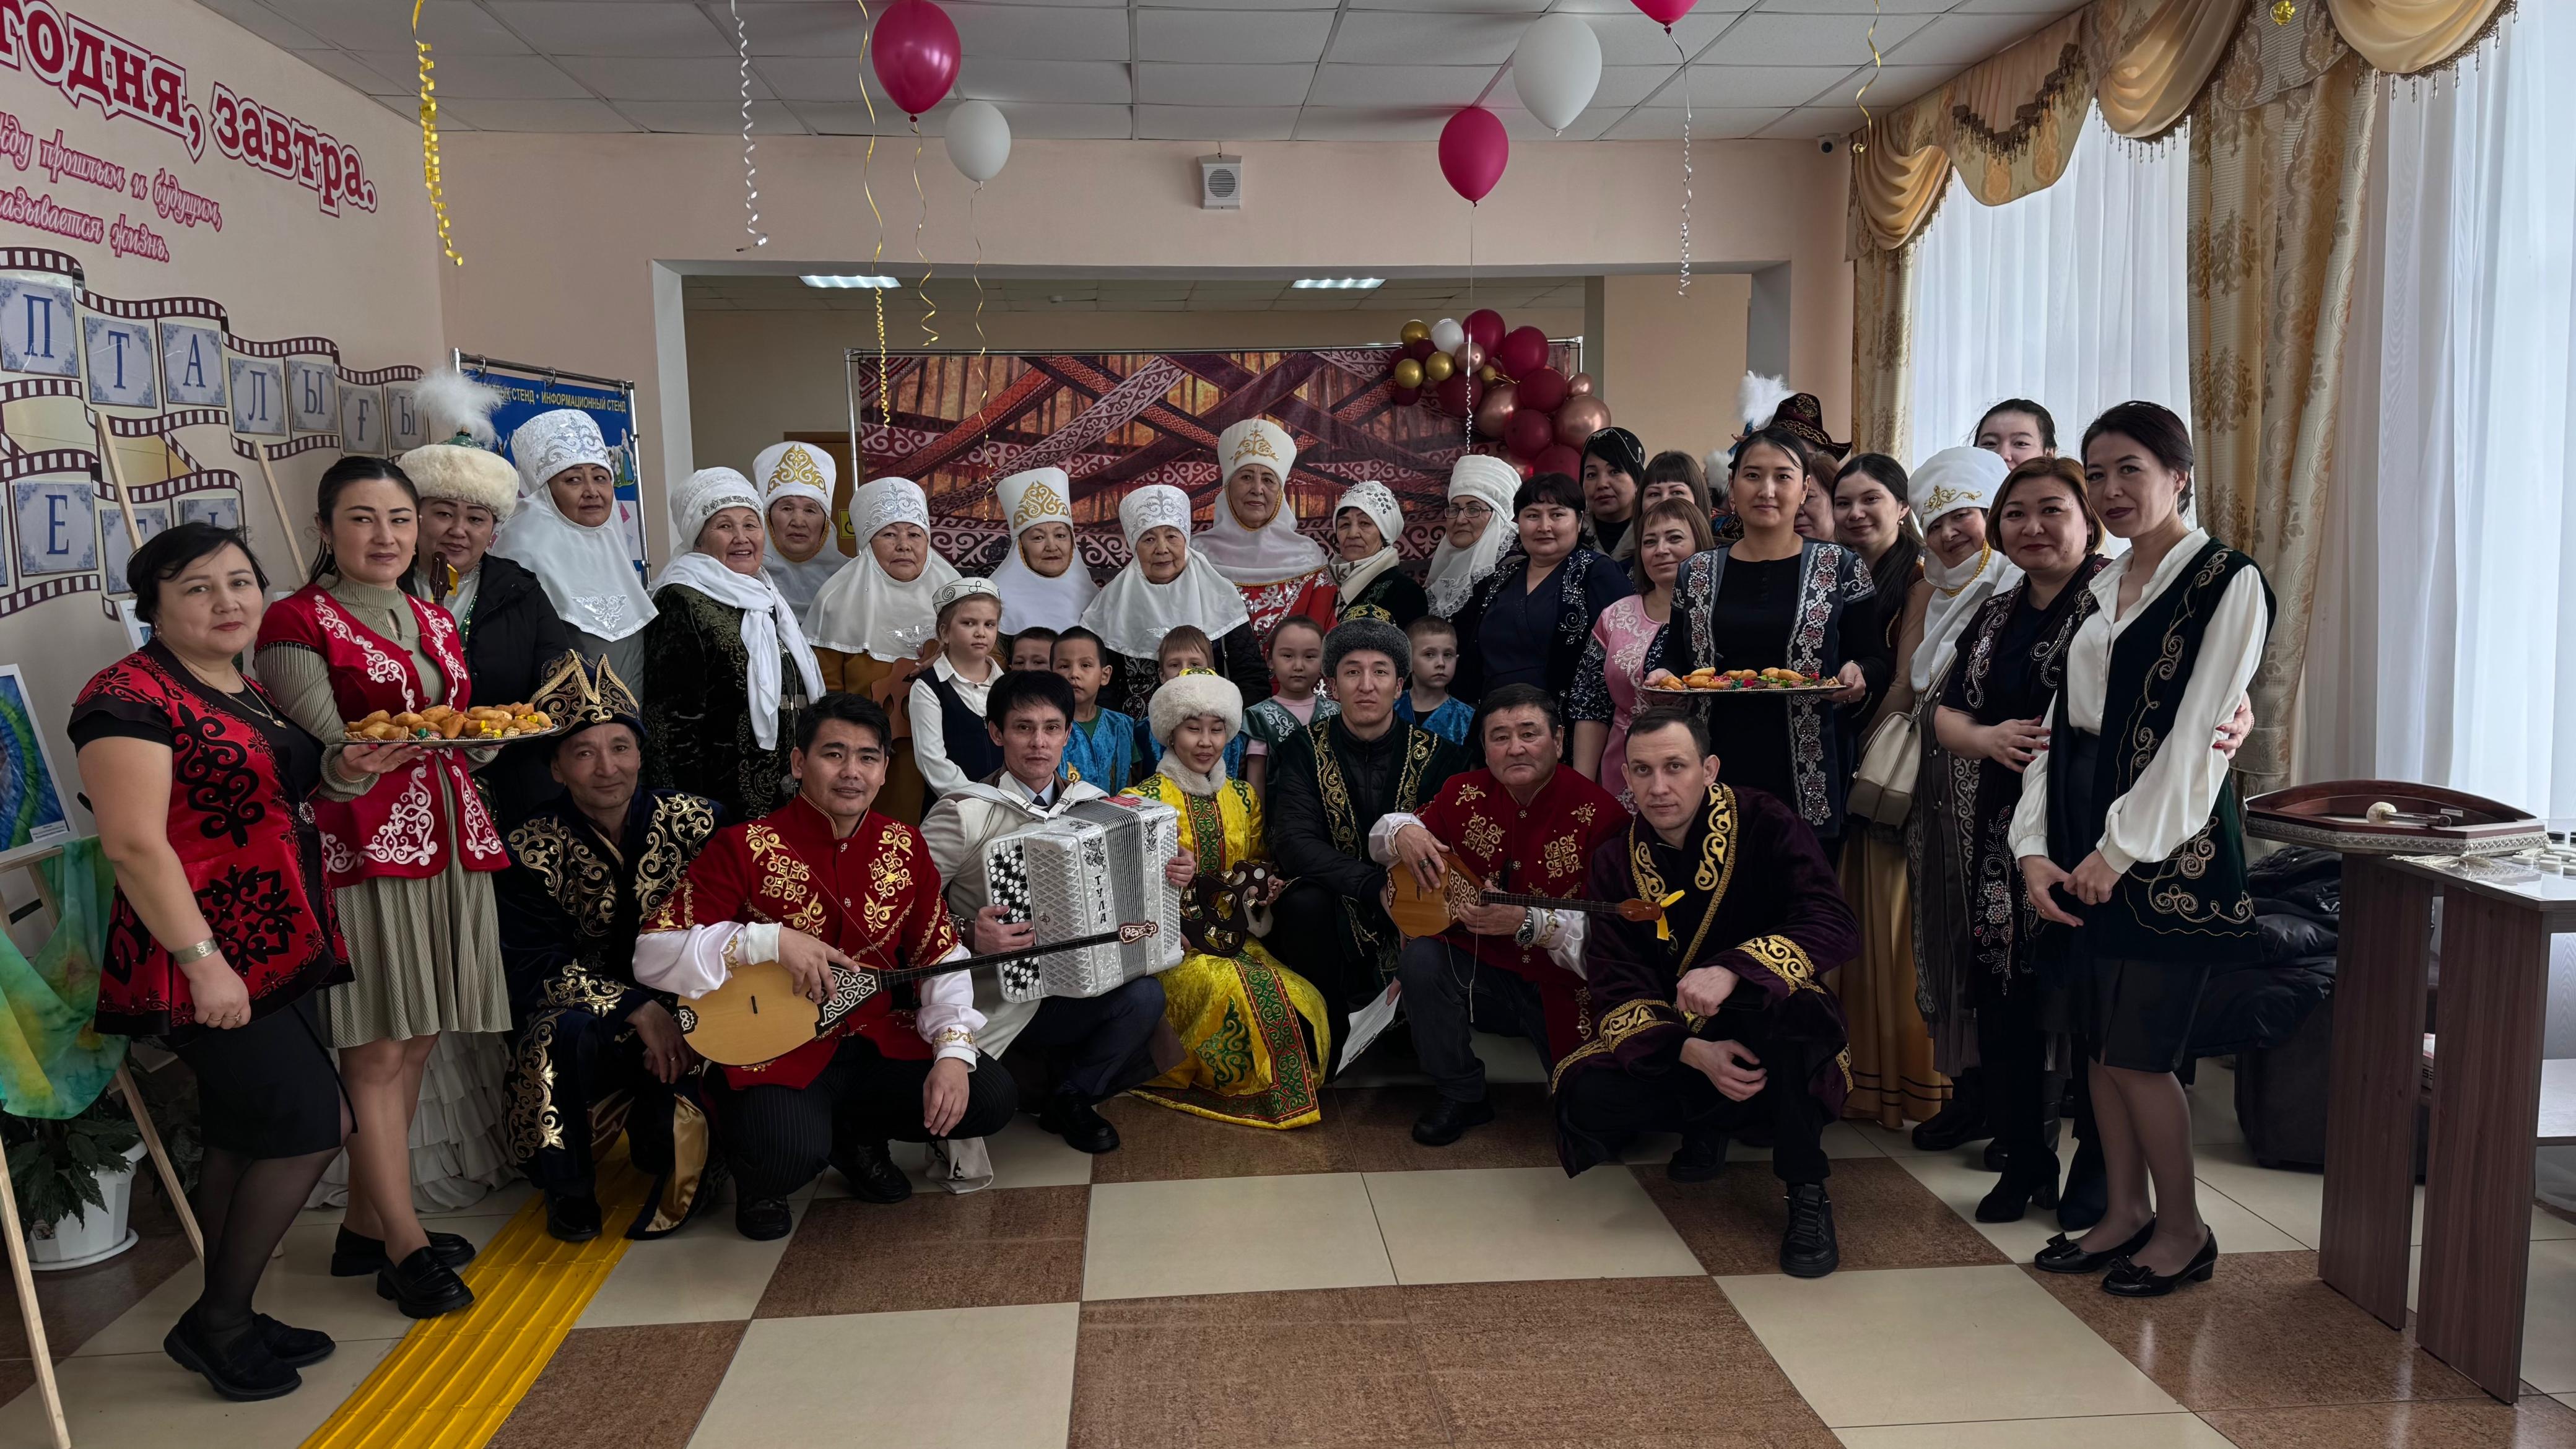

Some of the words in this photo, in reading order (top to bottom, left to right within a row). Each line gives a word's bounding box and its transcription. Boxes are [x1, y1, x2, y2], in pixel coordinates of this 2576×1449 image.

[211, 84, 376, 215] завтра.
[40, 129, 125, 192] прошлым
[132, 173, 147, 199] и
[154, 168, 222, 232] будущим,
[110, 214, 169, 263] жизнь.
[511, 388, 535, 405] СТЕНД
[541, 391, 606, 410] ИНФОРМАЦИОННЫЙ
[607, 399, 627, 414] СТЕНД
[1094, 875, 1107, 924] ТУЛА
